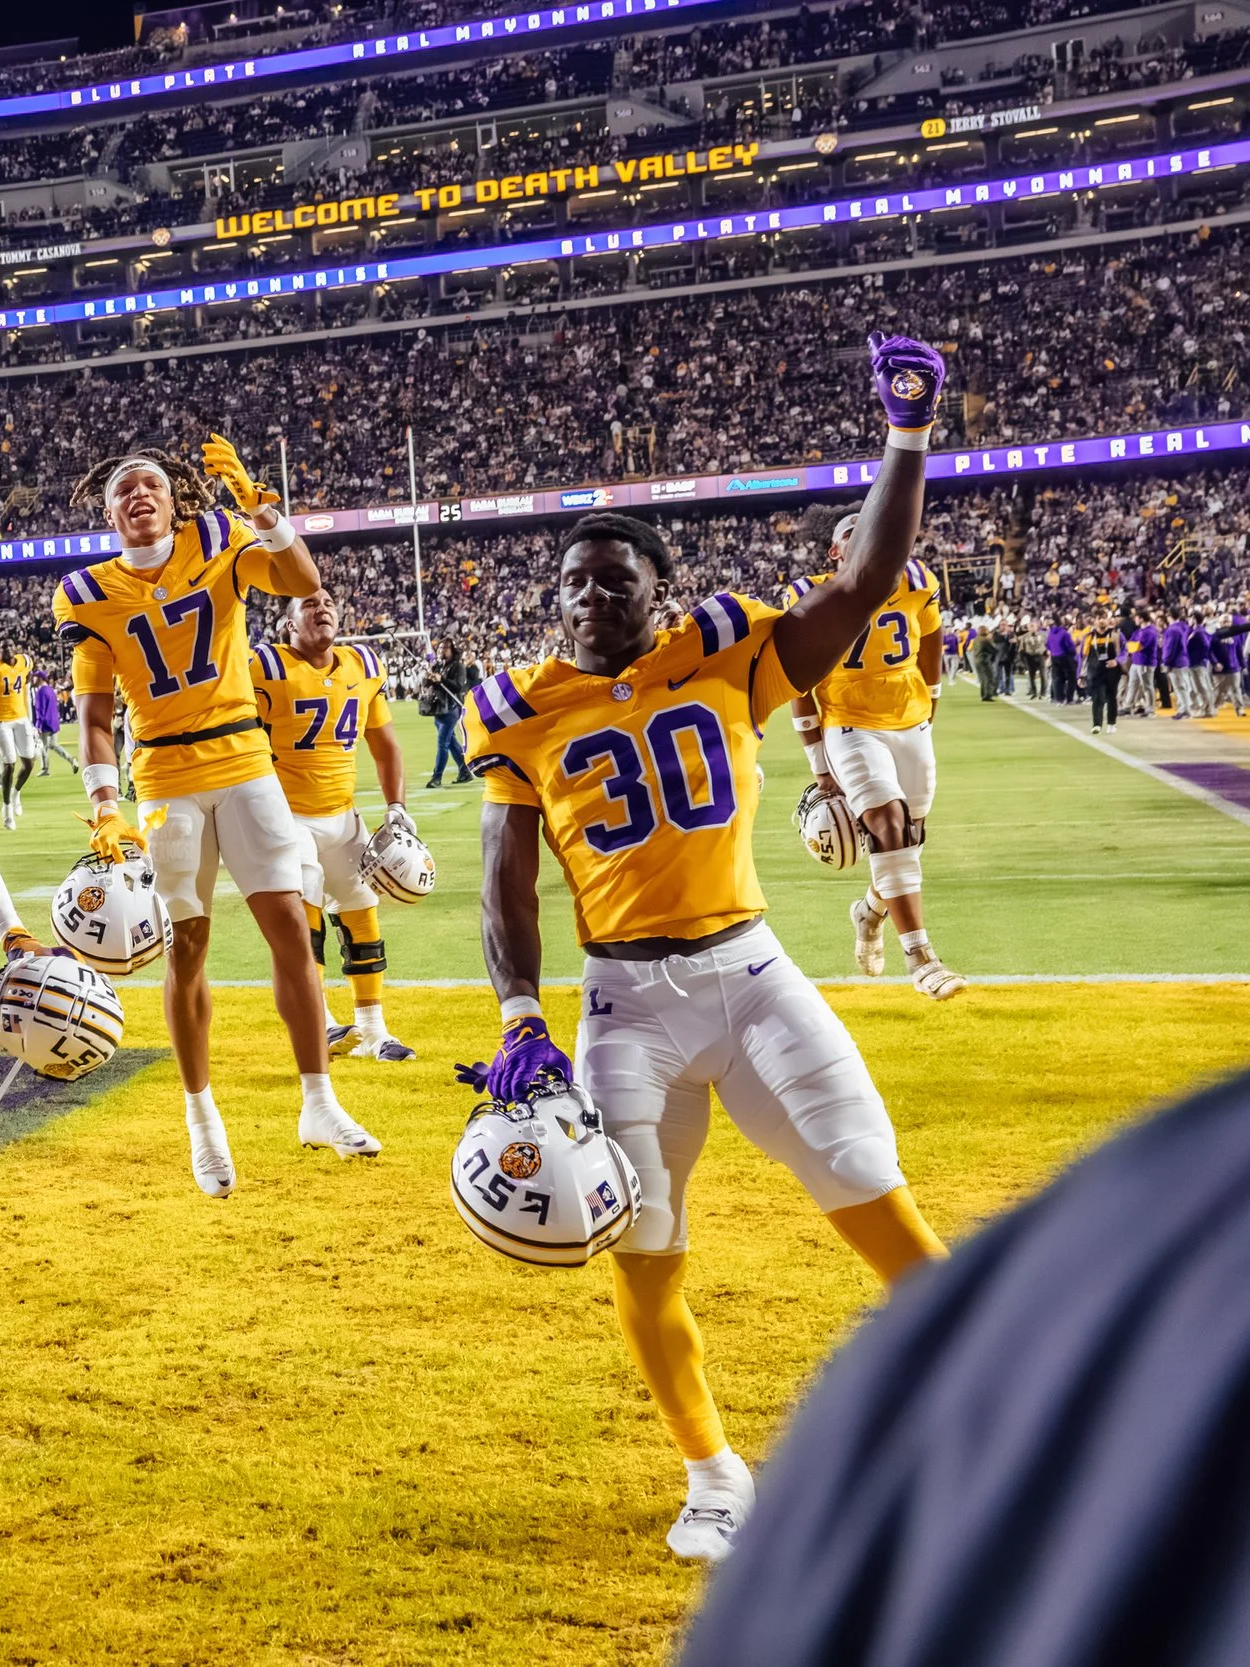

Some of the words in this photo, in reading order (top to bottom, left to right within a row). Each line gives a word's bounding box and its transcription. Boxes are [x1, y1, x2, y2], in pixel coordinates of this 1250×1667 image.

[71, 81, 140, 104] BLUE
[165, 62, 255, 89] PLATE
[353, 33, 429, 58] REAL
[927, 123, 939, 134] 21
[950, 115, 985, 133] JERRY
[991, 105, 1041, 127] STOVALL
[216, 193, 399, 239] WELCOME
[414, 184, 461, 211] TO
[476, 165, 599, 203] DEATH
[614, 142, 759, 183] VALLEY
[561, 230, 643, 254] BLUE
[673, 213, 780, 241] PLATE
[823, 195, 913, 222] REAL
[945, 150, 1211, 205] MAYONNAISE
[0, 249, 32, 265] TOMMY
[37, 243, 82, 260] CASANOVA
[84, 295, 155, 317] REAL
[180, 264, 388, 304] MAYONNAISE
[834, 465, 873, 484] BL
[955, 444, 1075, 473] PLATE
[1110, 429, 1209, 458] REAL
[439, 504, 462, 522] 25
[592, 489, 607, 506] 2
[127, 588, 220, 700] 17
[2, 674, 23, 697] 14
[294, 697, 360, 752] 74
[561, 701, 737, 856] 30
[588, 988, 613, 1016] L
[463, 1148, 551, 1226] LSU
